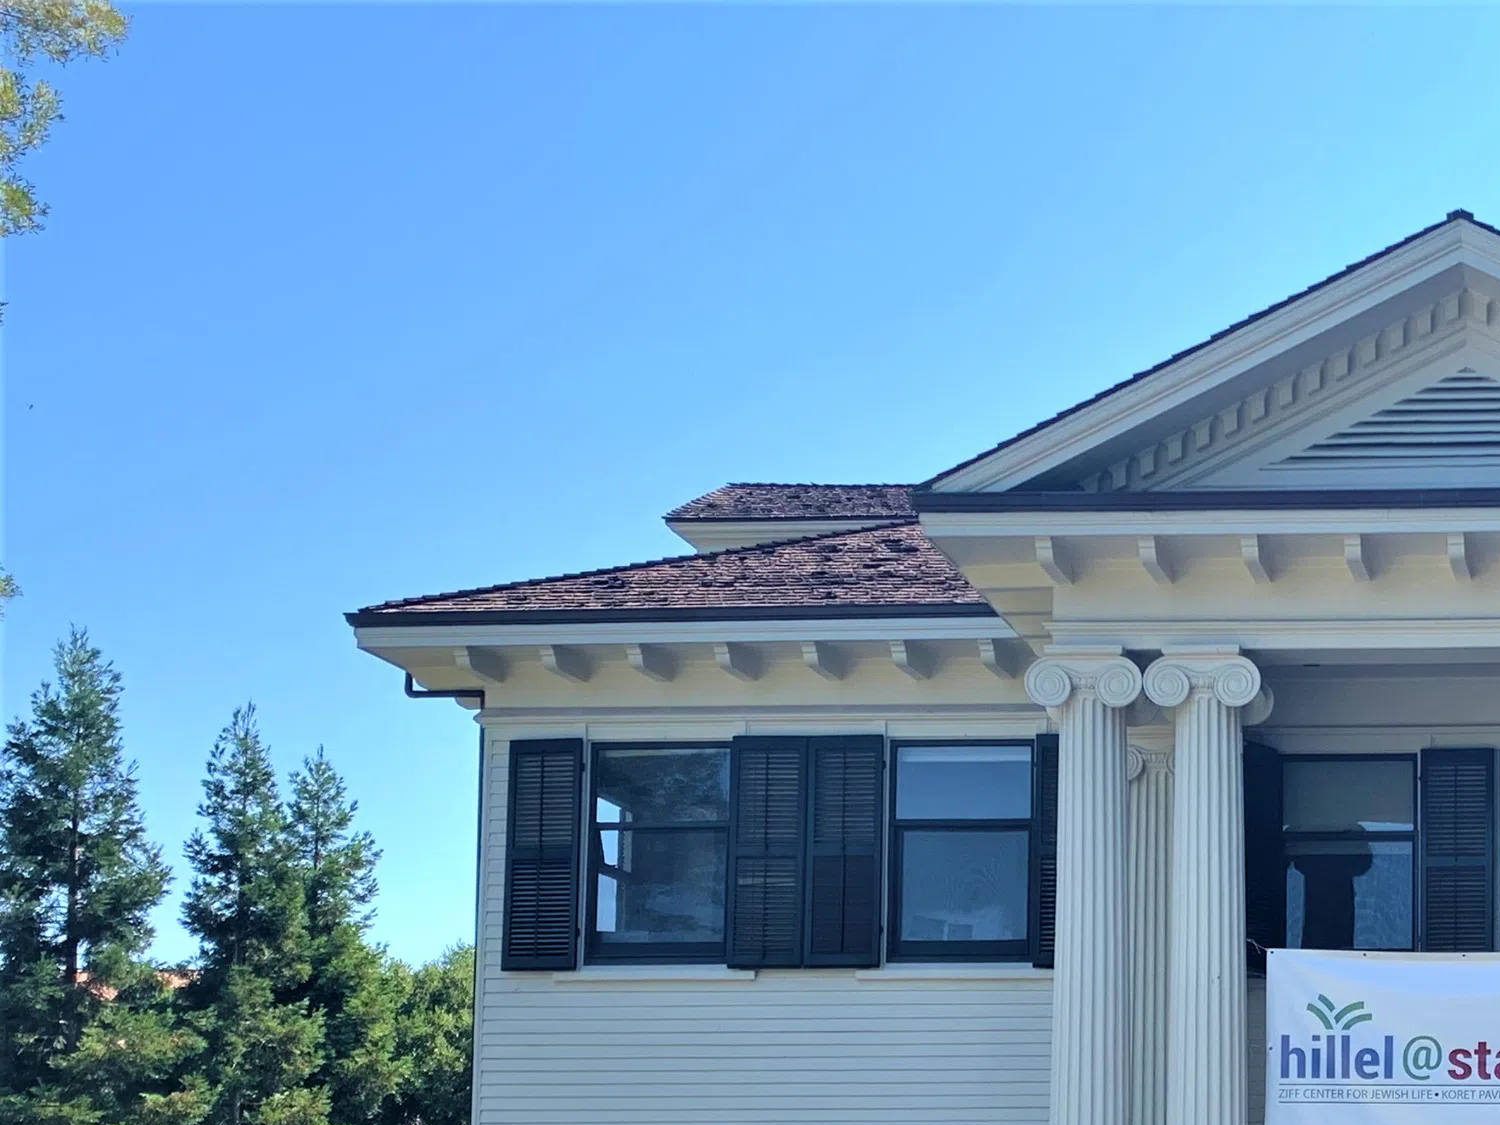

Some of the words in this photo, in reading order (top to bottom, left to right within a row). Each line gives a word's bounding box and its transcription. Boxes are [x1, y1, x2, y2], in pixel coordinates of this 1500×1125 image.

[1278, 1088, 1300, 1099] ZIFF
[1303, 1088, 1343, 1099] CENTER
[1346, 1089, 1368, 1099] FOR
[1370, 1089, 1409, 1100] JEWISH
[1411, 1089, 1433, 1100] LIFE
[1441, 1089, 1476, 1100] KORET
